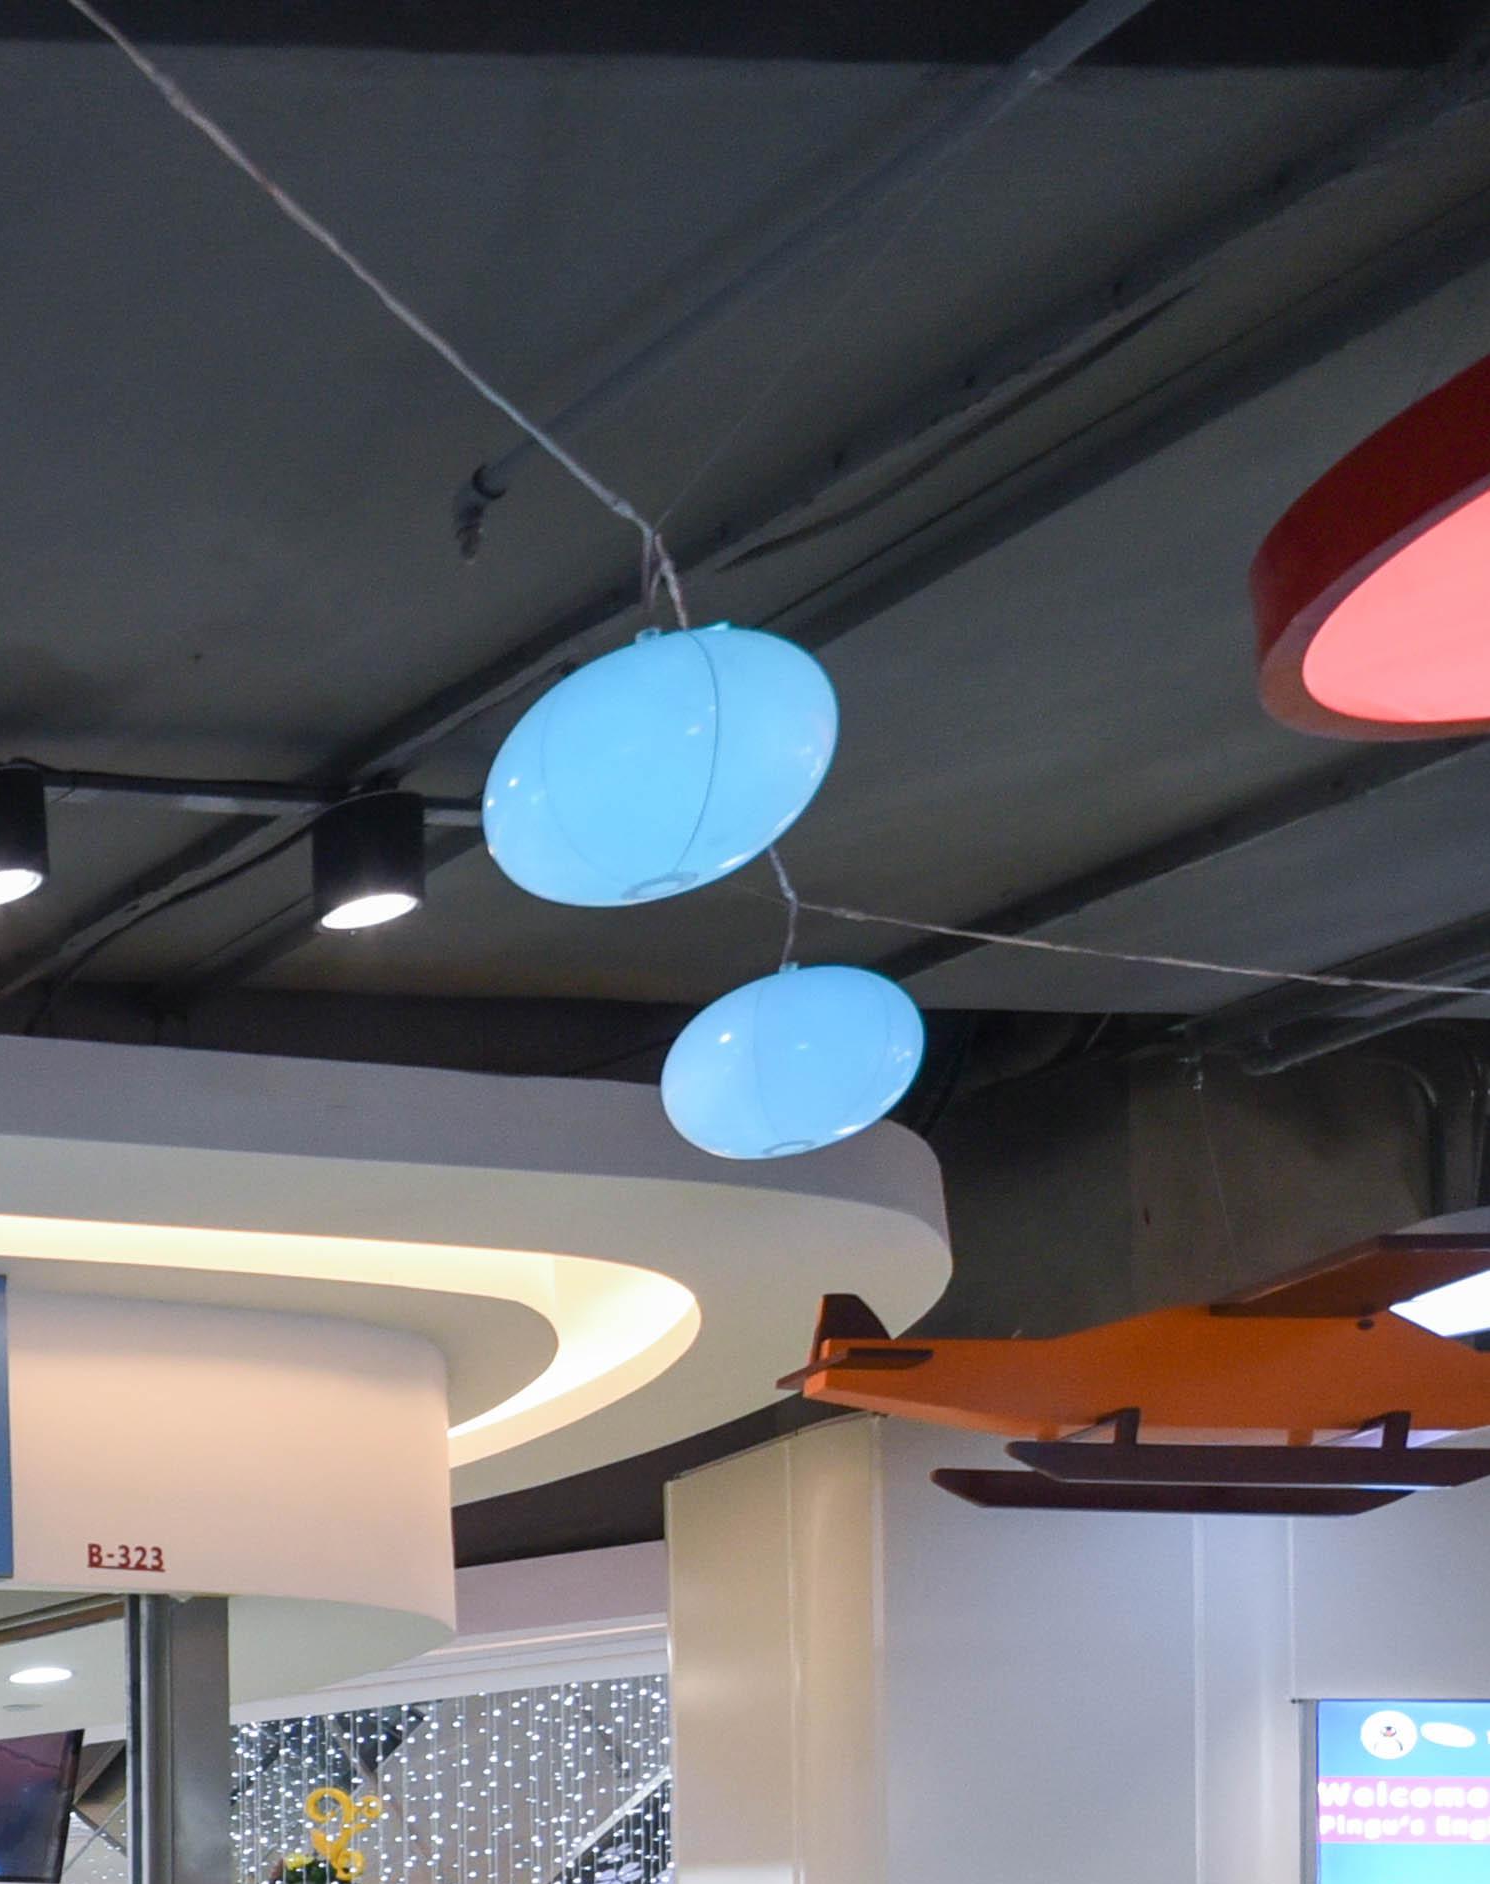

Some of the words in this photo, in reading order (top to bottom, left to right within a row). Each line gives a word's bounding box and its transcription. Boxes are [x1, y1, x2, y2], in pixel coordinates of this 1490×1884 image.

[87, 1543, 165, 1572] B-323
[1318, 1780, 1489, 1808] Welcome
[1319, 1813, 1426, 1841] Pingu's
[1435, 1814, 1490, 1841] Eng
